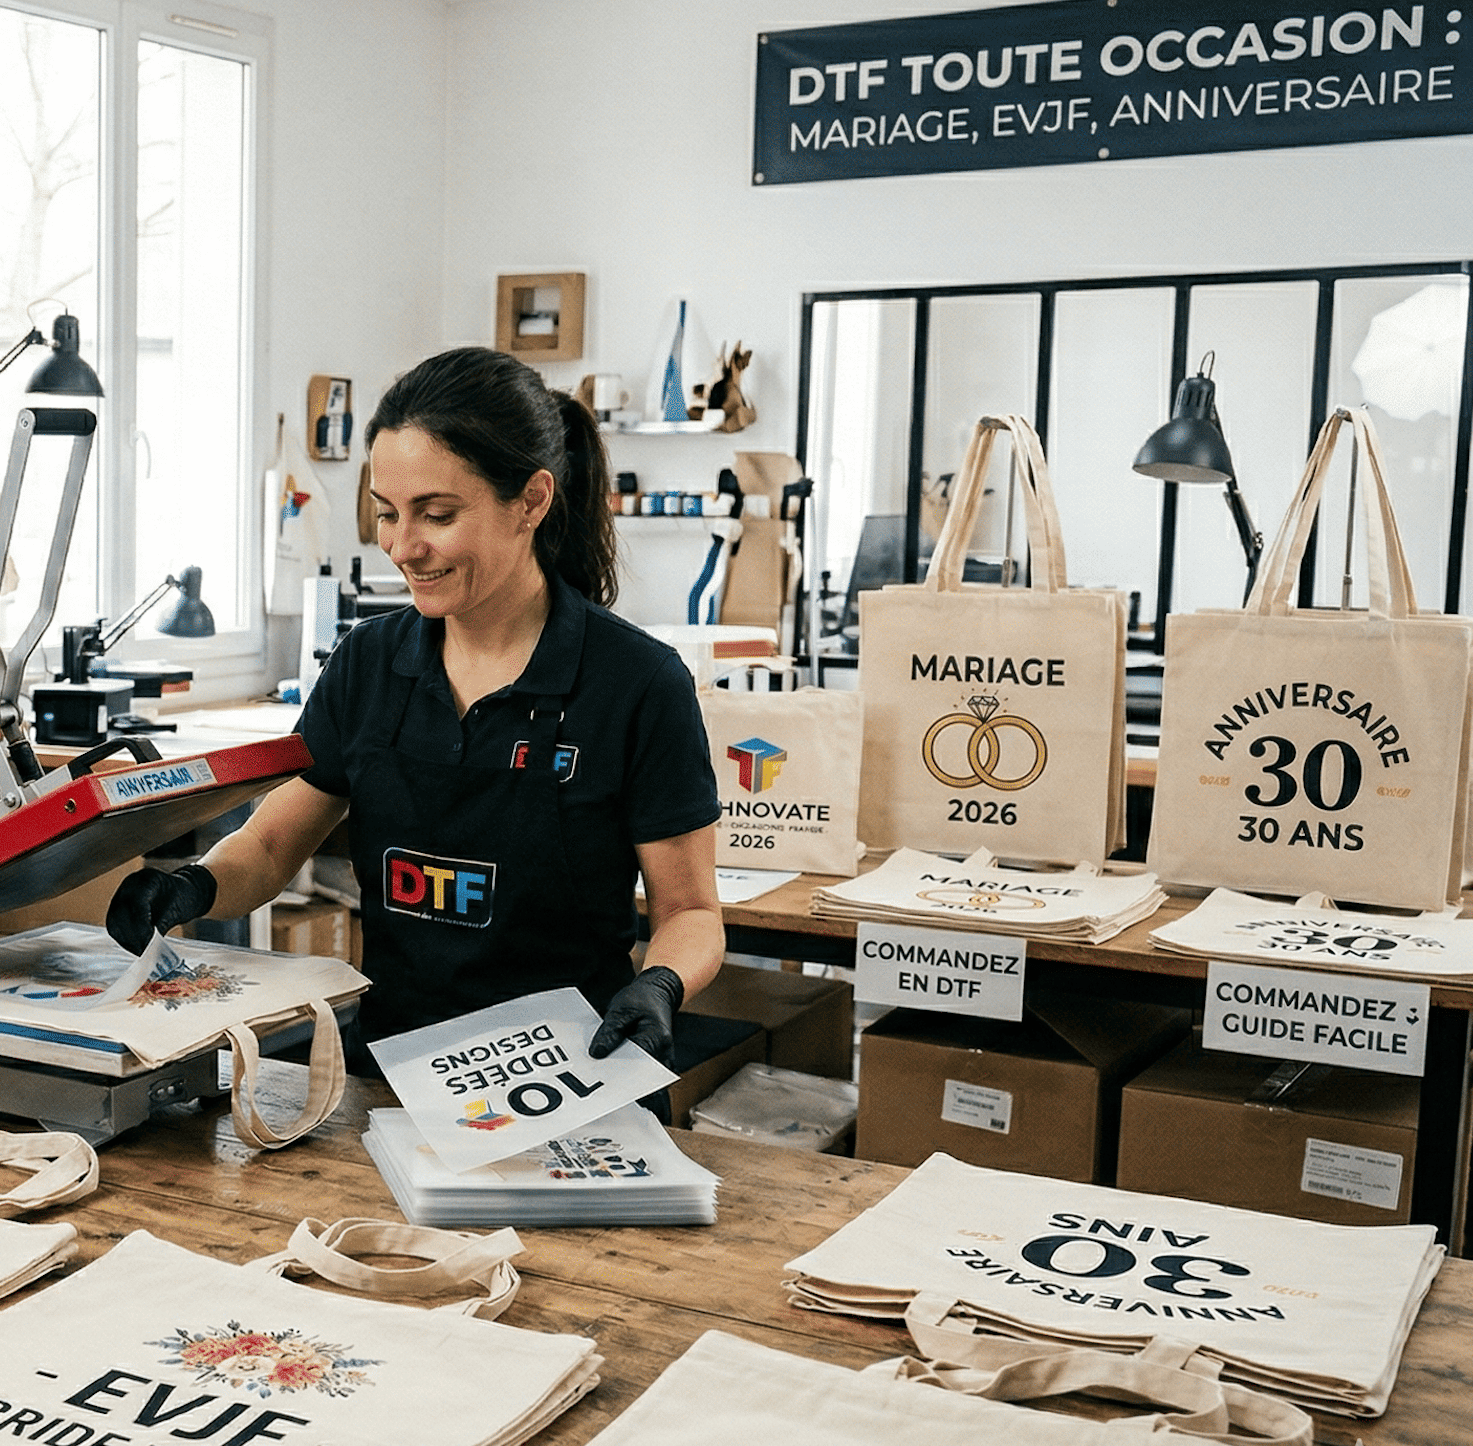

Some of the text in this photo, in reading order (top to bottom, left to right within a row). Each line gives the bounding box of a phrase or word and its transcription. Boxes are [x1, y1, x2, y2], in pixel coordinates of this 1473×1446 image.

[789, 59, 888, 105] DTF
[901, 40, 1083, 95] TOUTE
[1100, 5, 1424, 76] OCCASION
[790, 65, 1455, 151] MARIAGE, EVJF, ANNIVERSAIRE
[911, 654, 1065, 686] MARIAGE
[1204, 682, 1410, 768] ANNIVERSAIRE
[1245, 736, 1362, 811] 30
[947, 799, 1018, 826] 2026
[1237, 816, 1365, 851] 30 ANS
[729, 833, 775, 849] 2026
[390, 859, 487, 914] DTF
[920, 874, 1084, 897] MARIAGE
[863, 940, 1020, 976] COMMANDEZ
[1271, 928, 1398, 951] 30
[899, 972, 982, 999] EN DTF
[1216, 982, 1397, 1022] COMMANDEZ
[431, 1024, 554, 1074] DESIGNS
[1222, 1013, 1408, 1055] GUIDE FACILE
[507, 1071, 605, 1117] 10
[946, 1246, 1285, 1321] ANNIVERSAIRE
[1021, 1235, 1251, 1299] 30
[64, 1369, 311, 1446] EVJF
